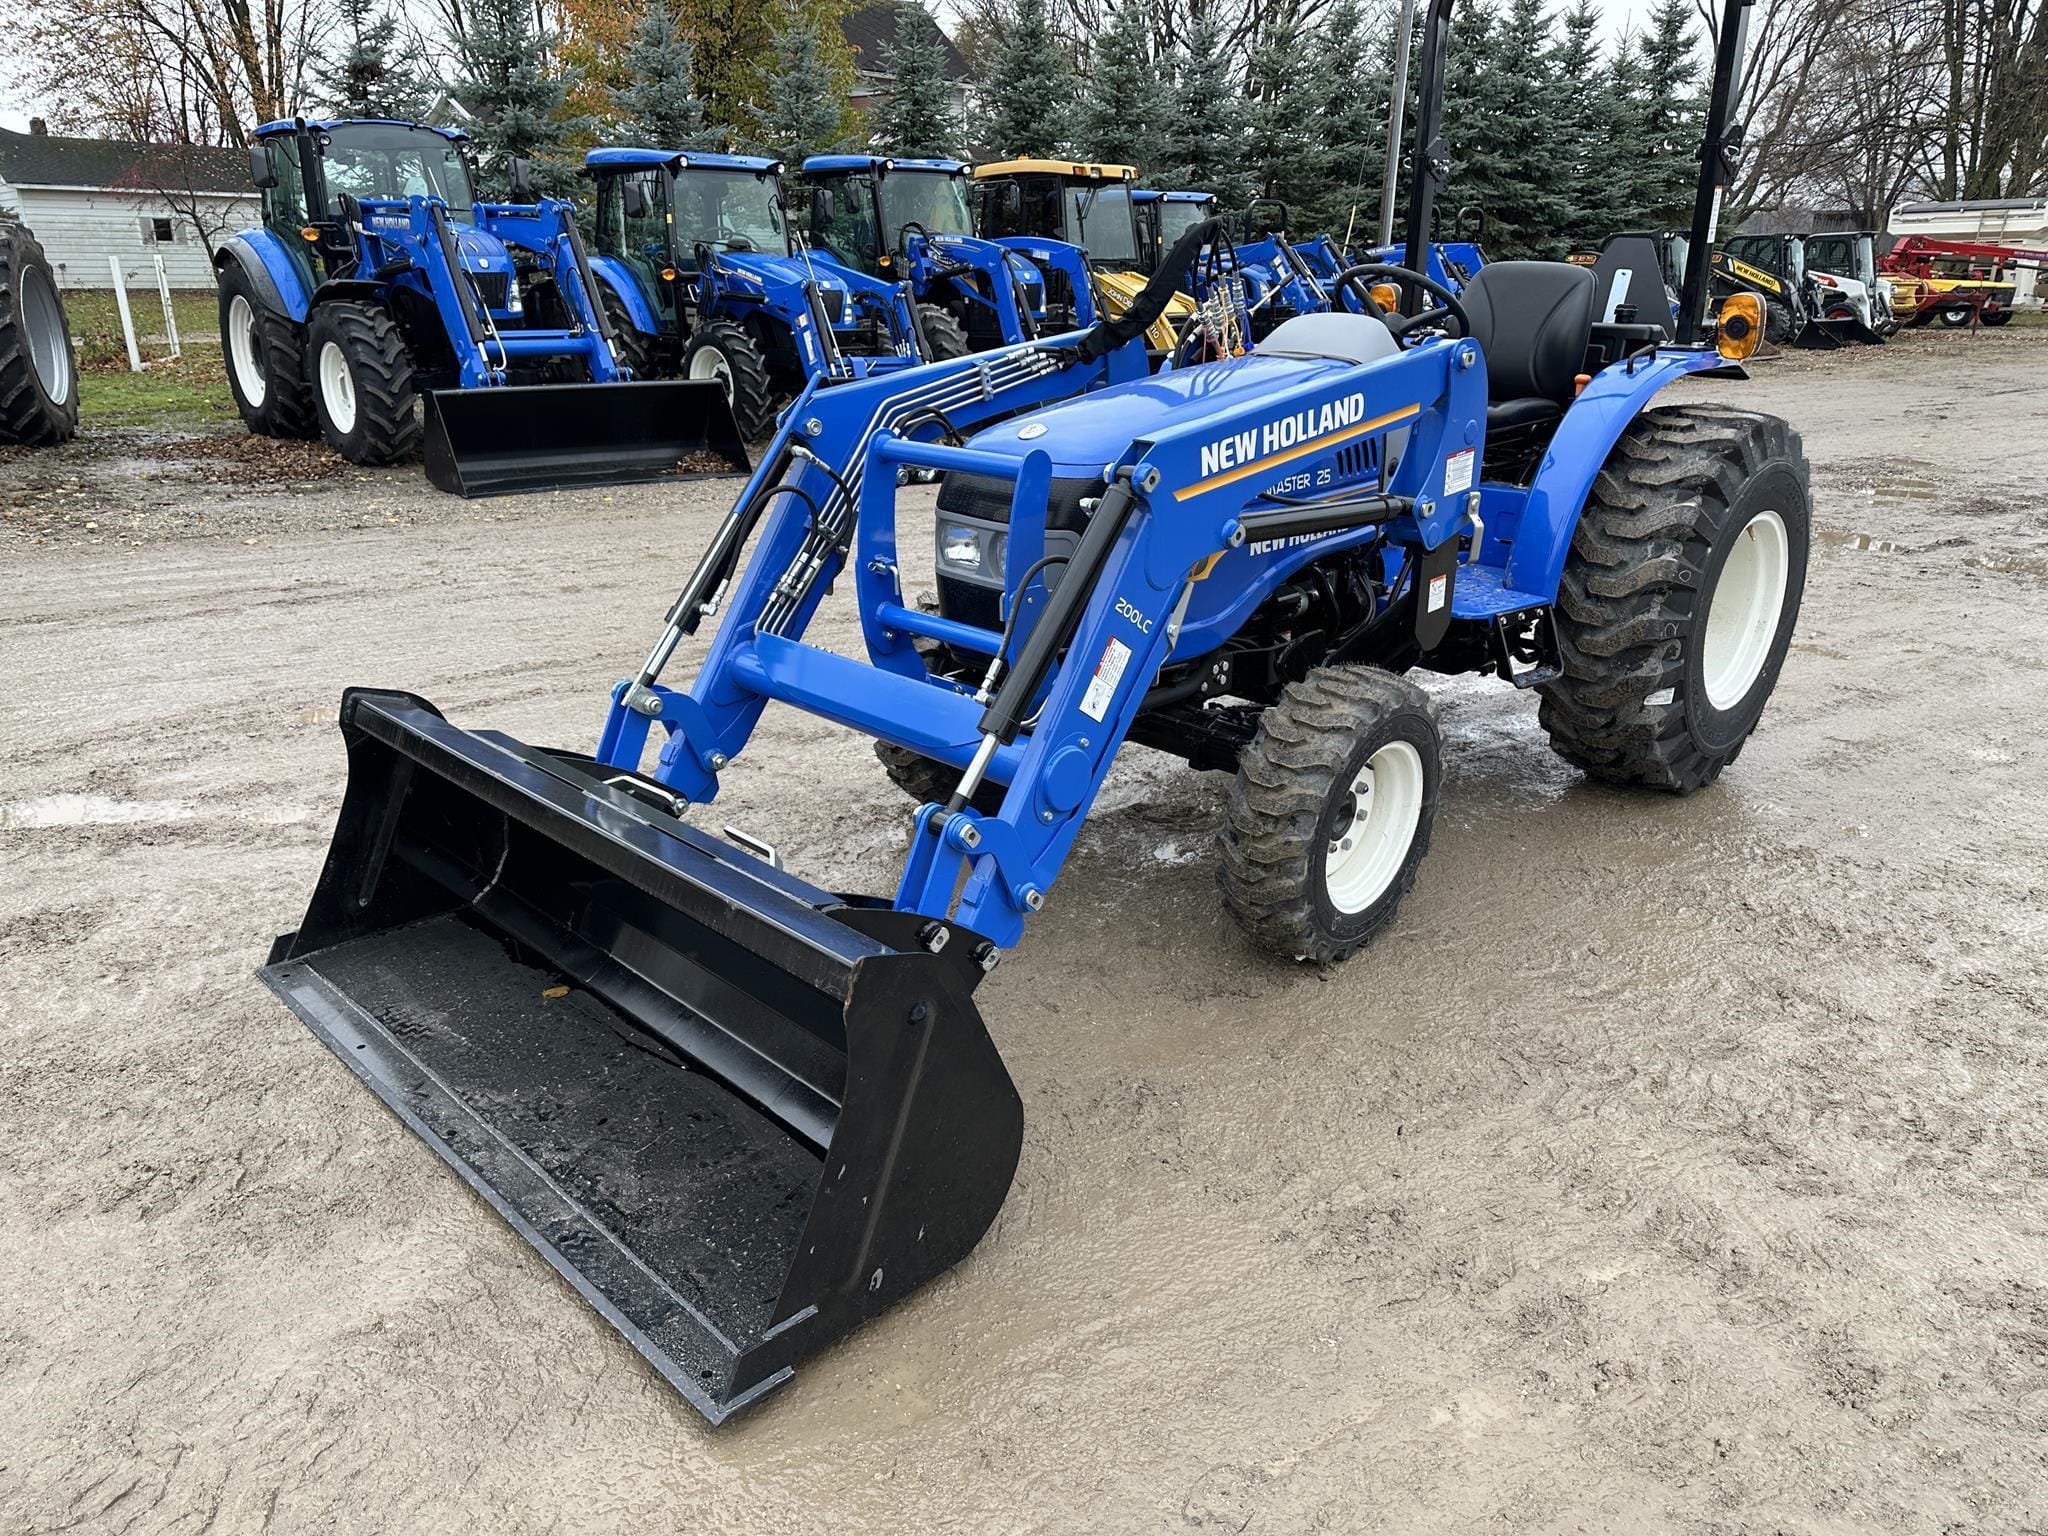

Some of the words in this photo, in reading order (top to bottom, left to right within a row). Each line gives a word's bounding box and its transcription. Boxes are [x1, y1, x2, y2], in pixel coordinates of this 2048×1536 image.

[1201, 428, 1258, 478] NEW
[1262, 392, 1365, 456] HOLLAND
[1316, 468, 1331, 486] 25
[1114, 596, 1153, 634] 200LC
